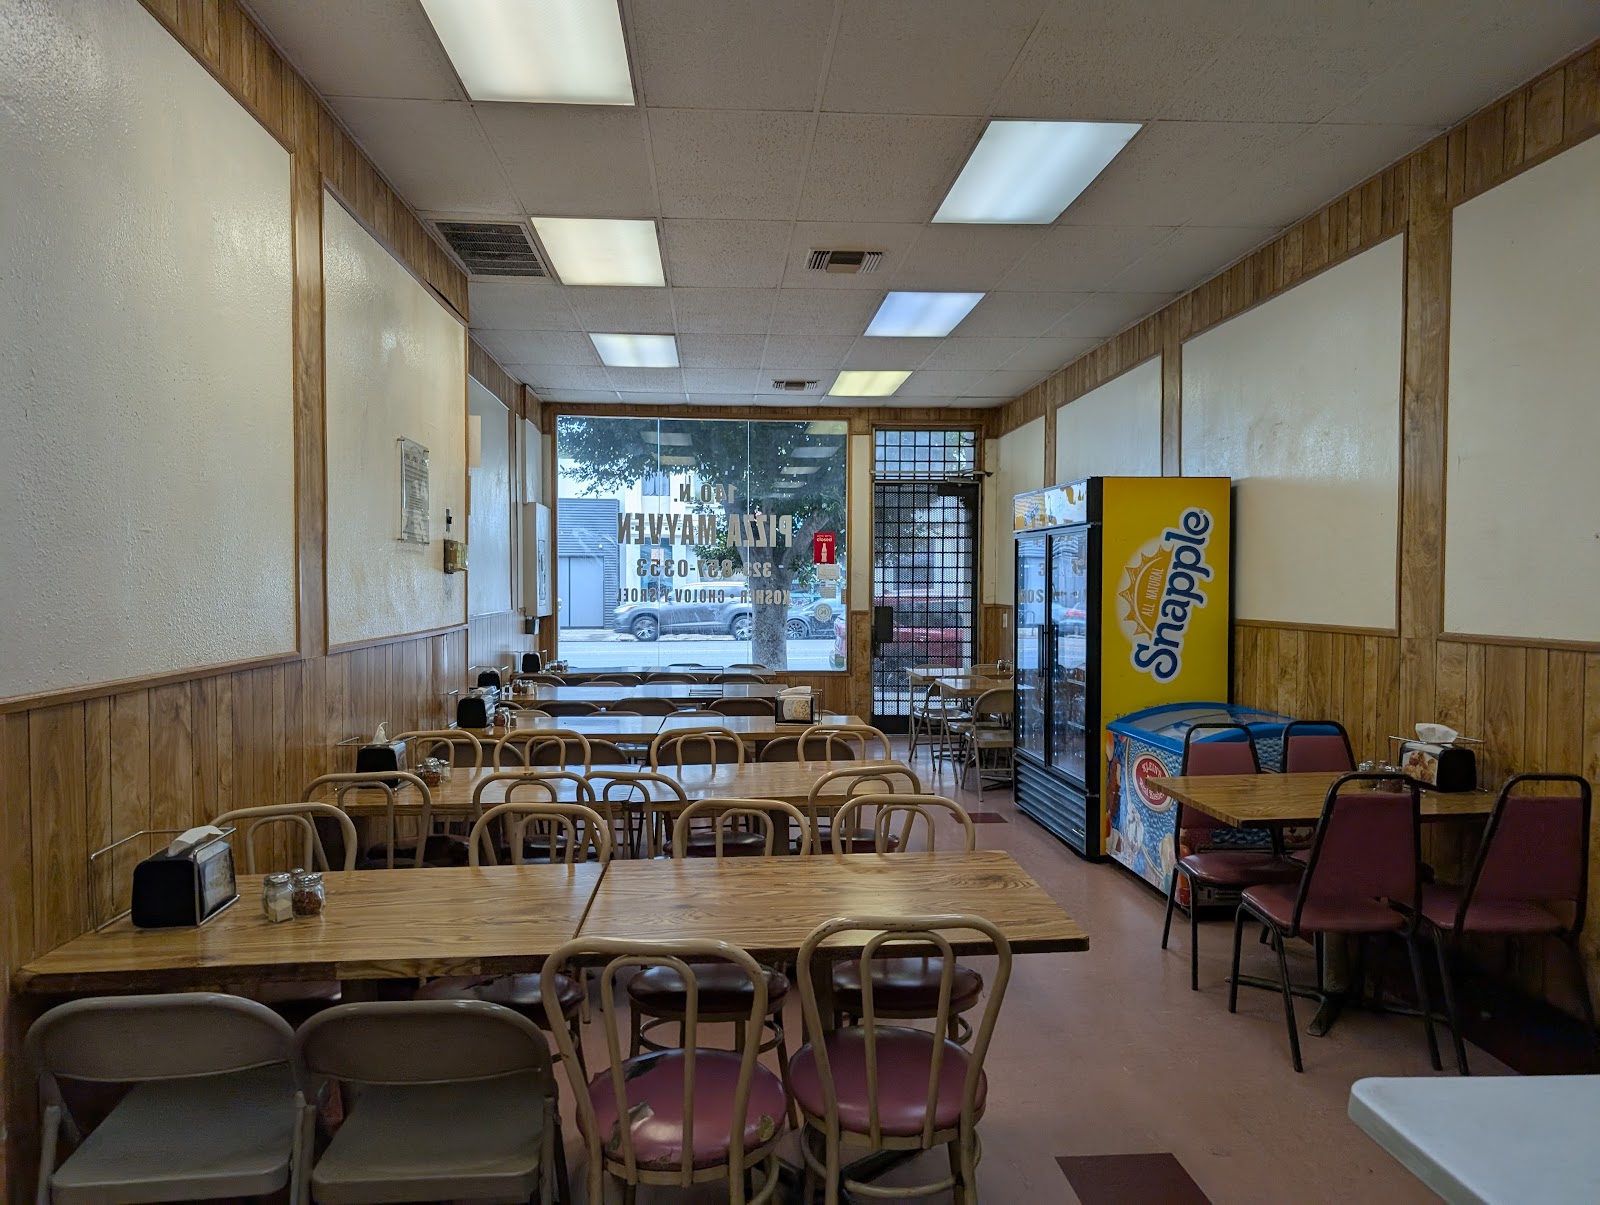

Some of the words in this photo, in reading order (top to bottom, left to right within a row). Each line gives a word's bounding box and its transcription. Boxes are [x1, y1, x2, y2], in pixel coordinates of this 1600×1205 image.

[1134, 510, 1210, 679] Snapple
[1145, 567, 1164, 600] NATURAL
[1141, 603, 1155, 617] ALL
